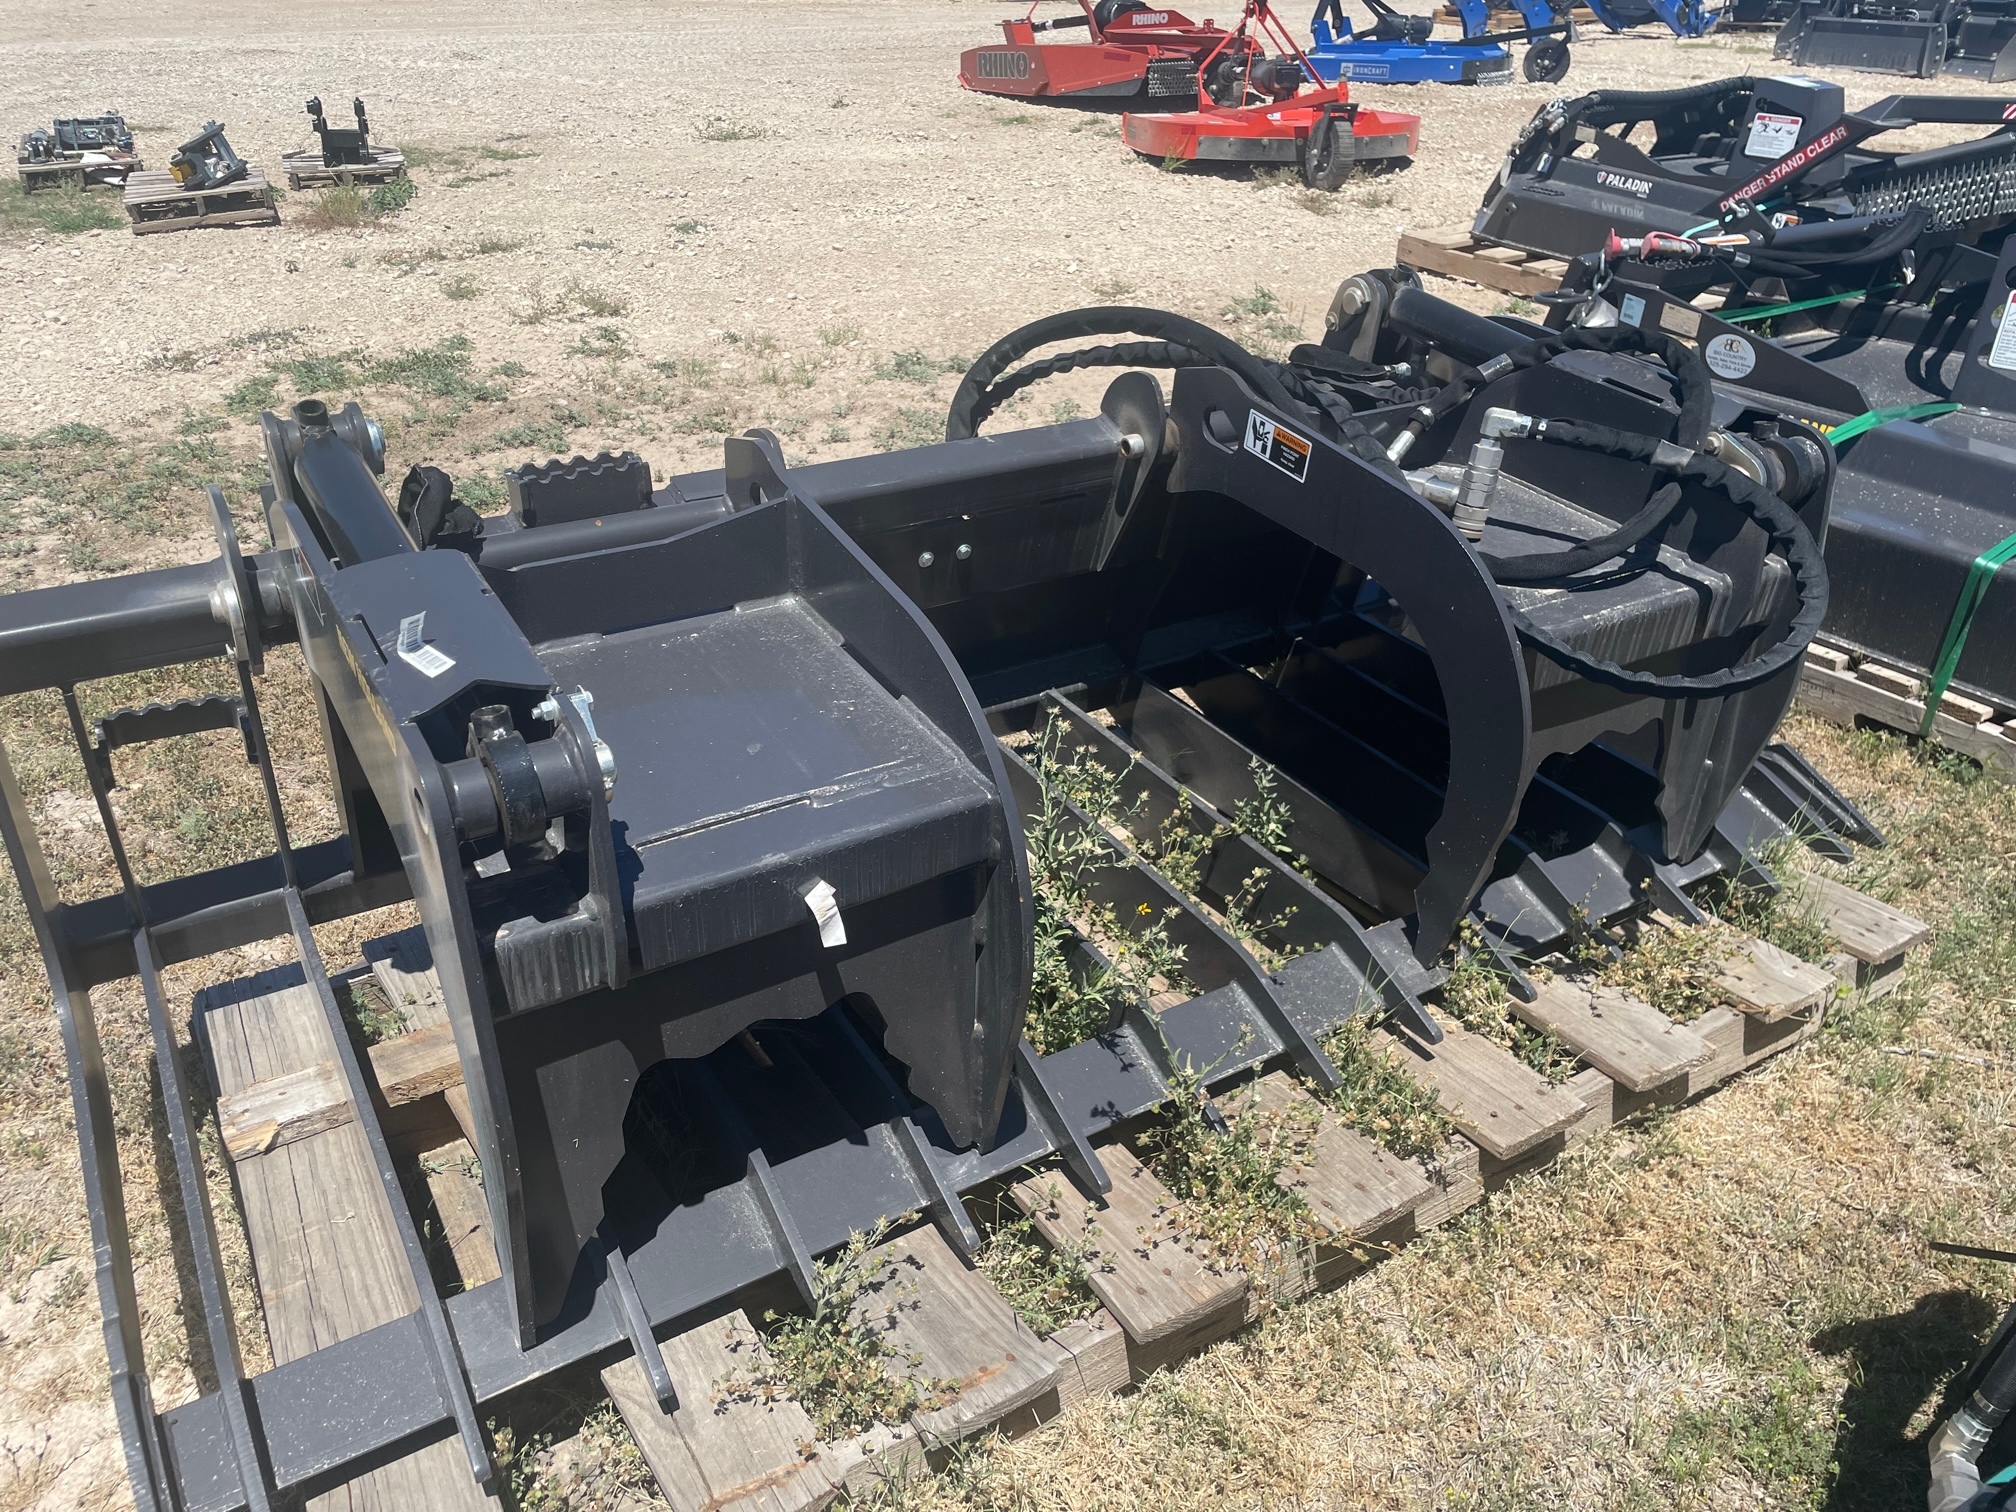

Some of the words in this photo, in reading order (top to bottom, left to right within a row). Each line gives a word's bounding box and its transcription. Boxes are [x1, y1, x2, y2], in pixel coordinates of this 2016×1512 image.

[1132, 12, 1169, 26] RHINO
[977, 51, 1029, 80] RHINO
[1720, 177, 1767, 213] DANGER
[1767, 152, 1806, 184] STAND
[1806, 126, 1848, 159] CLEAR
[1605, 173, 1653, 194] PALADIN
[1723, 353, 1747, 361] COUNTRY
[1282, 433, 1306, 452] WARNING
